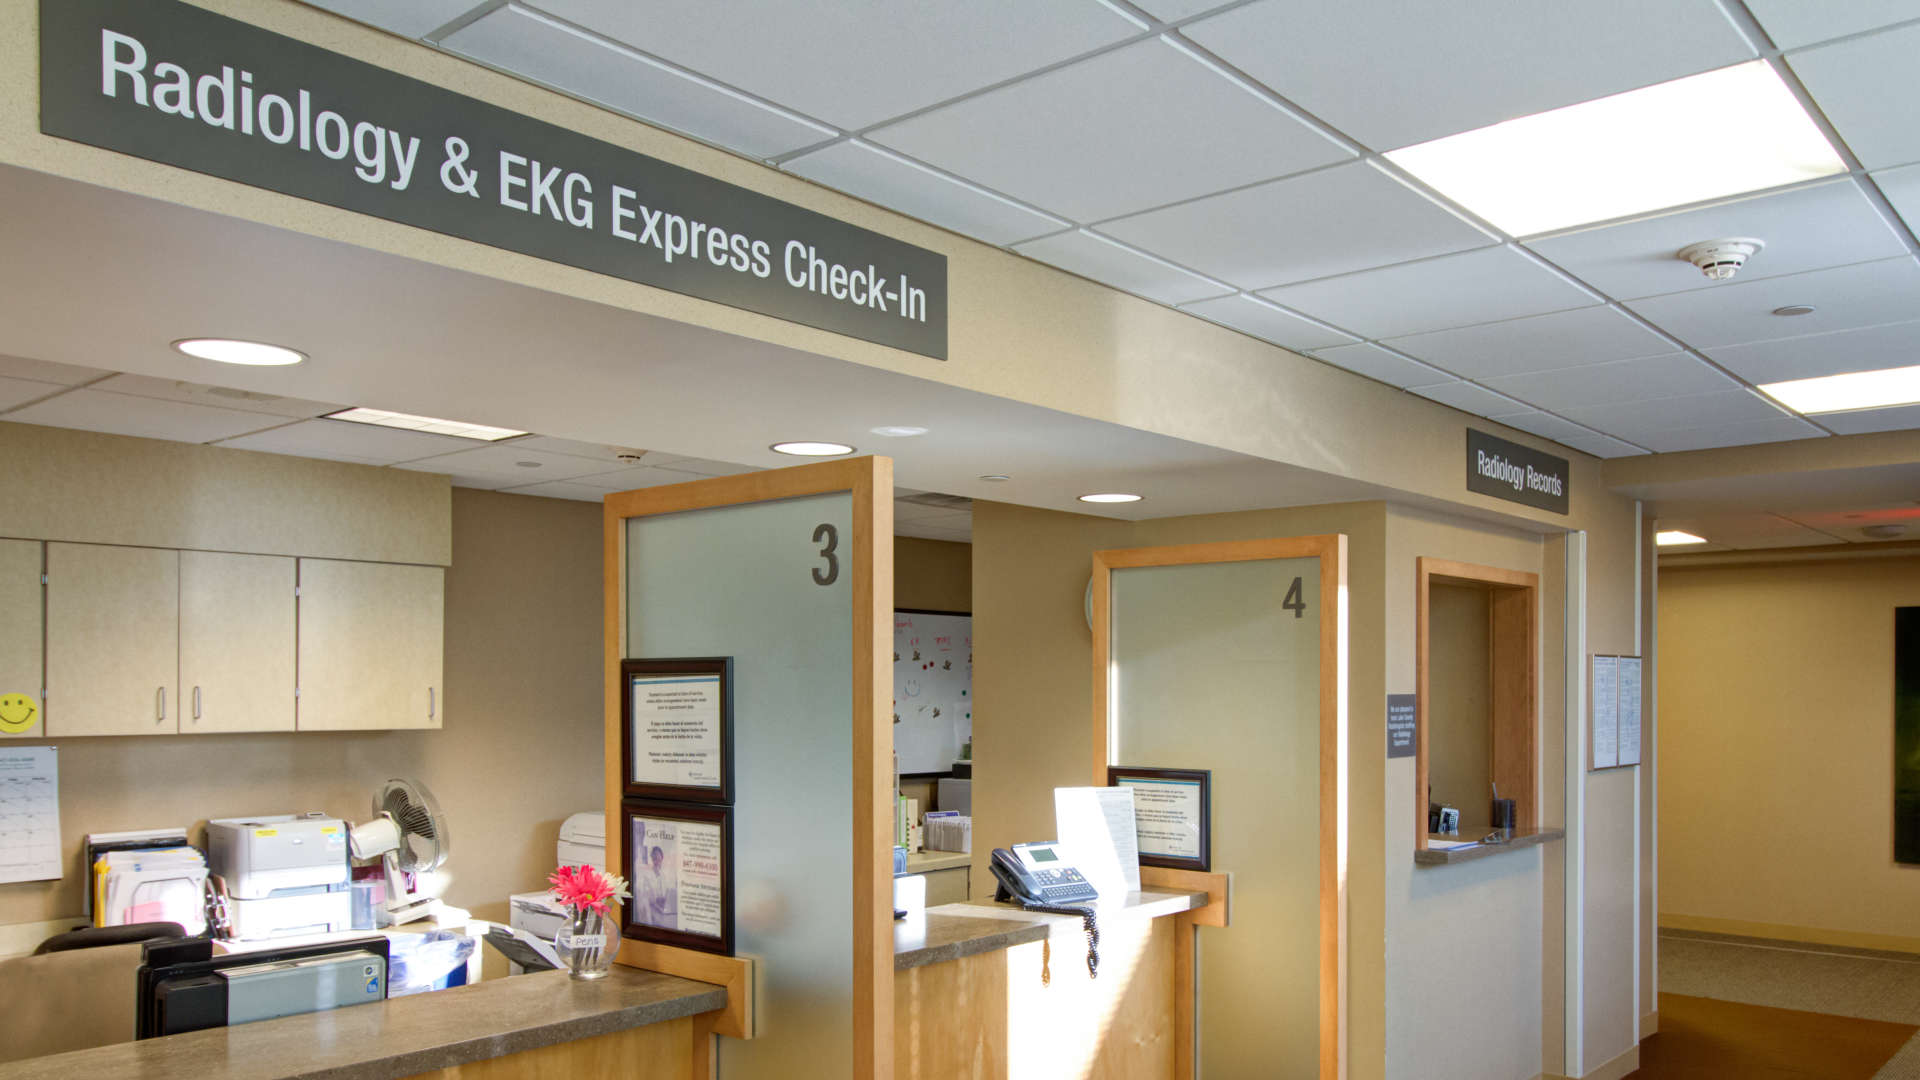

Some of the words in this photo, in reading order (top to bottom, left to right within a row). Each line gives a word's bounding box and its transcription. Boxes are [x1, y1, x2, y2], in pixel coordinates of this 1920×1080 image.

[102, 28, 421, 191] Radiology
[439, 136, 480, 199] &
[500, 150, 593, 230] EKG
[612, 184, 771, 279] Express
[784, 240, 926, 323] Check-In
[1477, 449, 1525, 492] Radiology
[1526, 464, 1562, 497] Records
[811, 523, 839, 586] 3
[1282, 576, 1306, 619] 4
